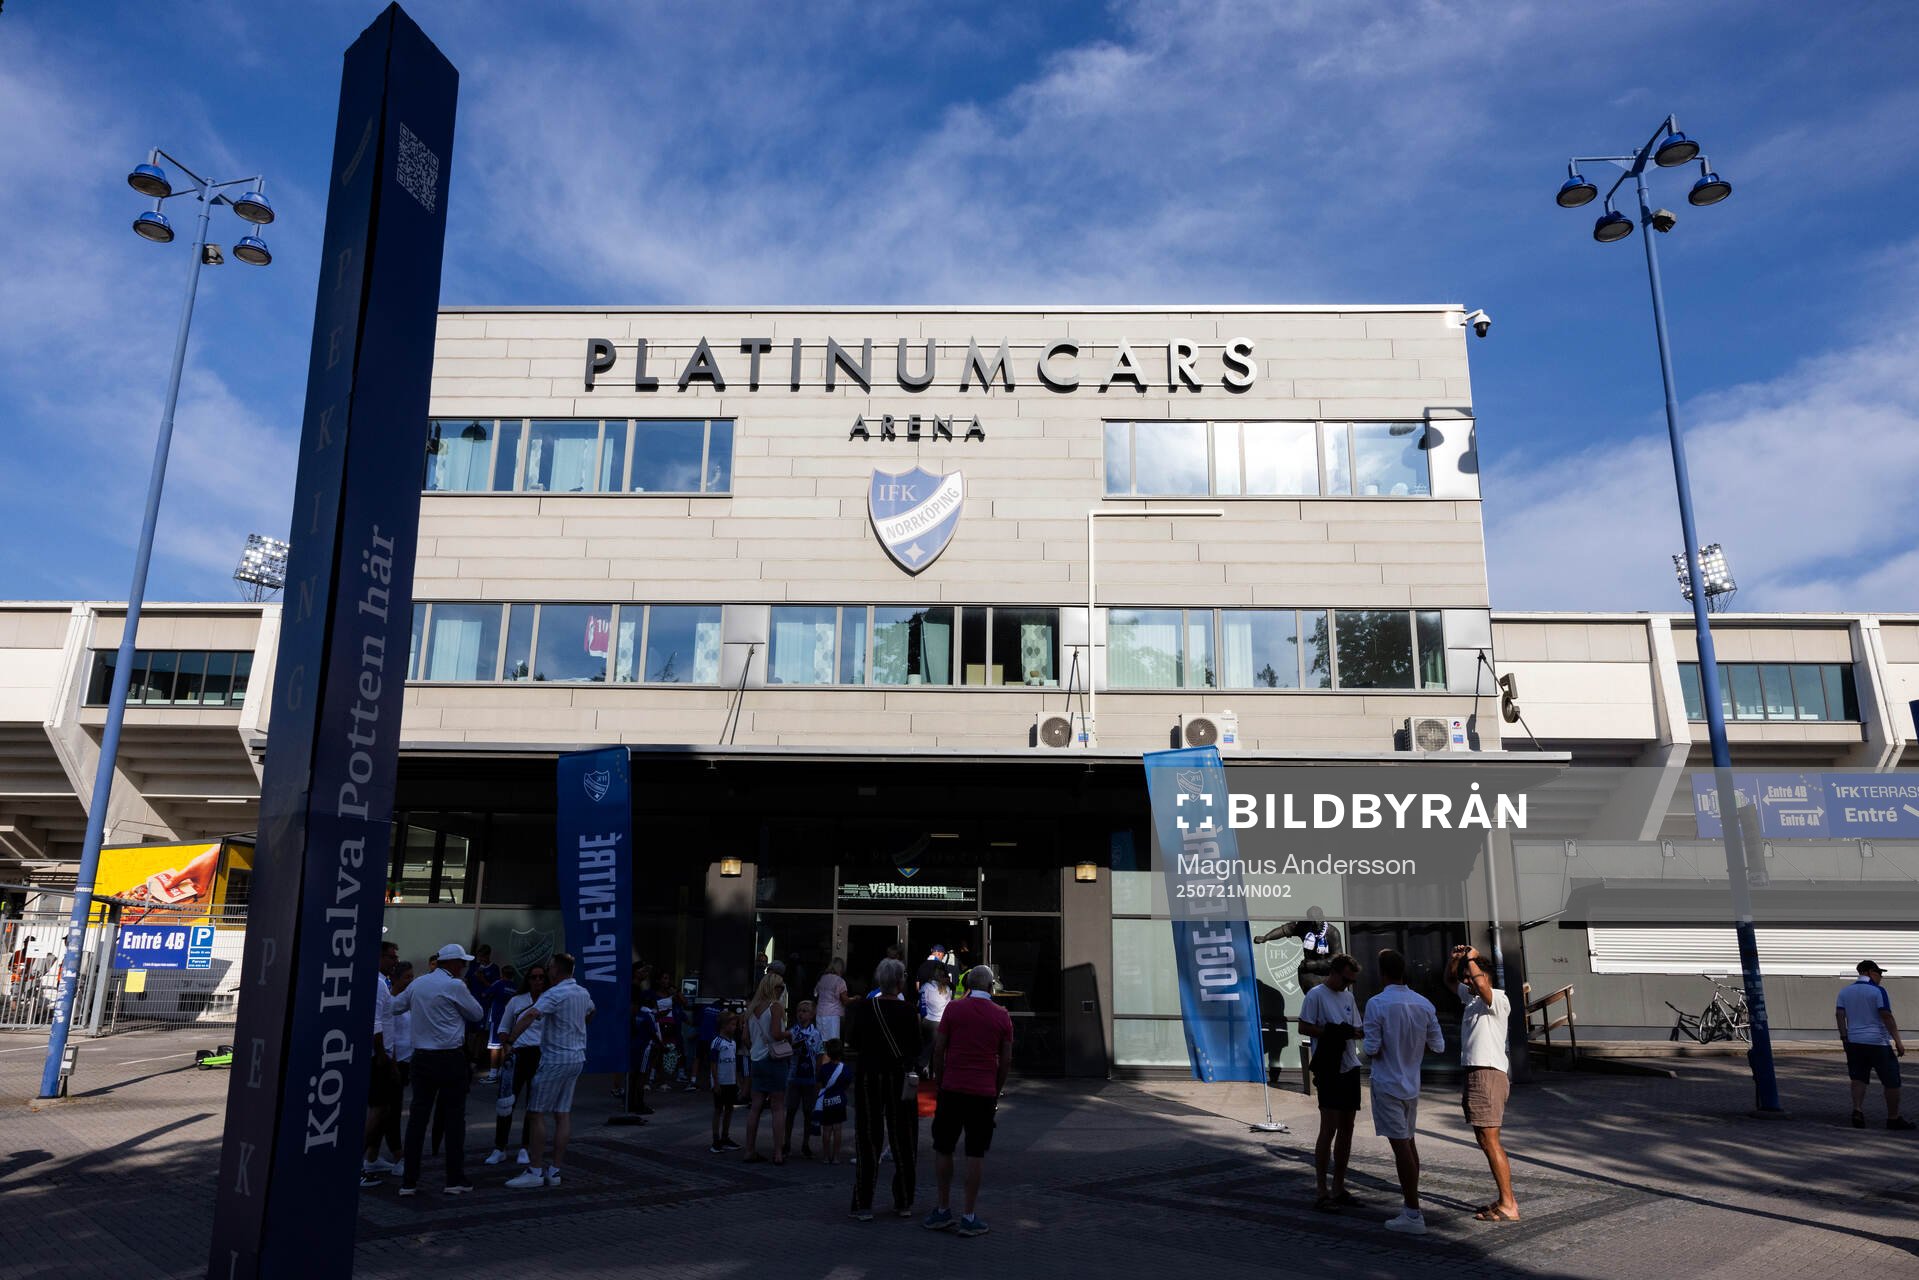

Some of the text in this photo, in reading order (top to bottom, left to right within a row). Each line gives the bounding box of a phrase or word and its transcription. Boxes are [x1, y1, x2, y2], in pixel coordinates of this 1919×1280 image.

[584, 336, 1257, 393] PLATINUMCARS
[849, 412, 986, 441] ARENA
[879, 484, 918, 502] IFK
[885, 487, 960, 539] NORRKÖPING
[1768, 785, 1807, 798] Entré 4B
[1781, 814, 1820, 826] Entré 4A
[1845, 807, 1898, 822] Entré
[304, 524, 396, 1154] Köp Halva Potten här
[869, 882, 947, 894] Välkommen
[123, 931, 185, 950] Entré 4B
[196, 928, 211, 946] P
[1270, 949, 1289, 959] IFK
